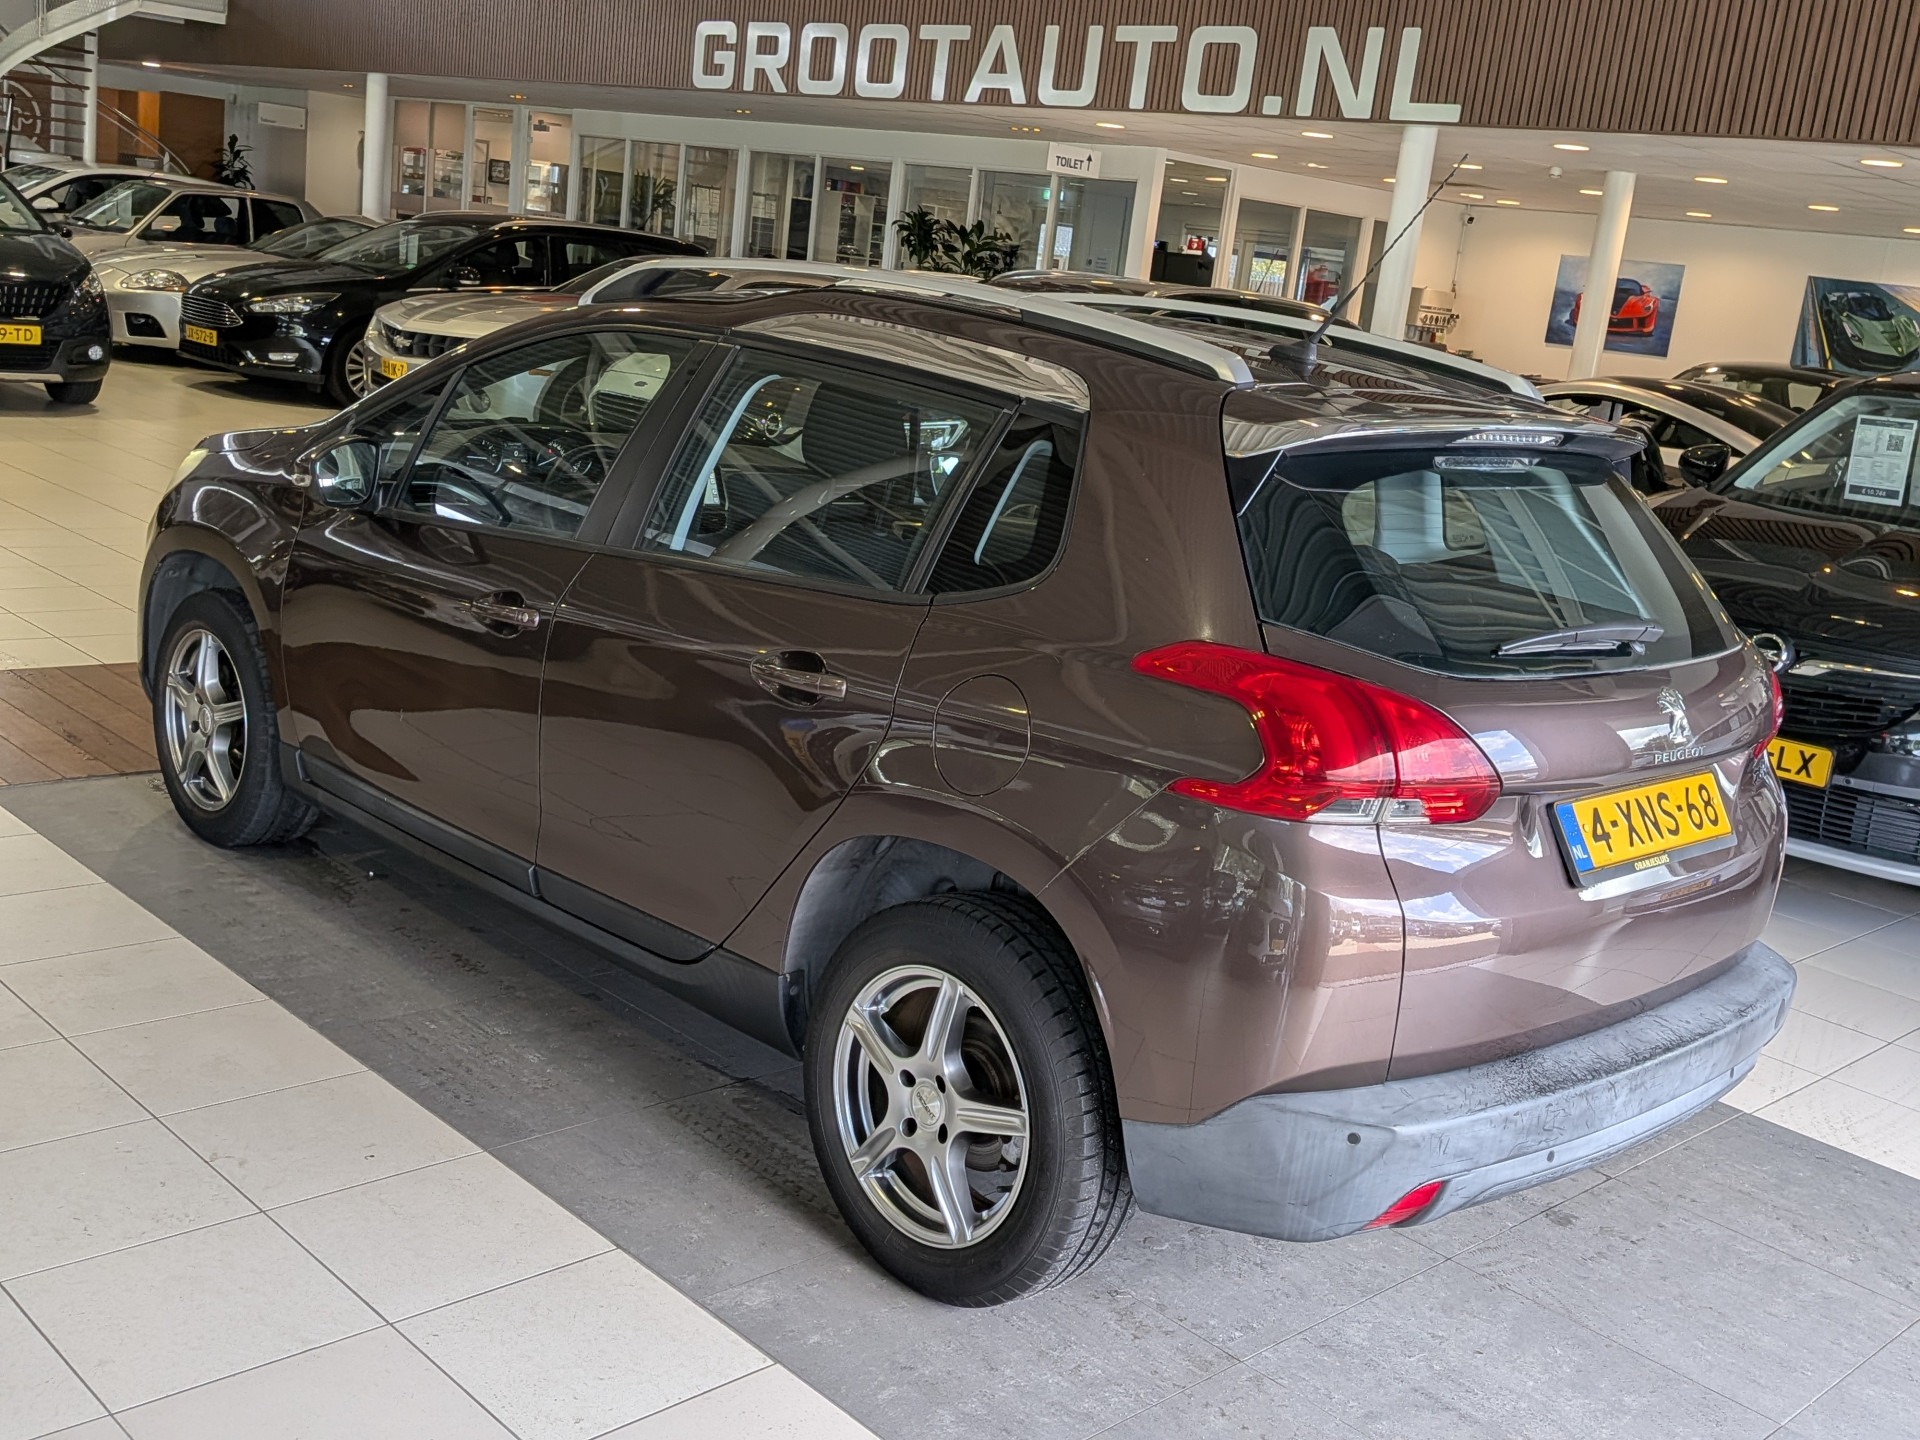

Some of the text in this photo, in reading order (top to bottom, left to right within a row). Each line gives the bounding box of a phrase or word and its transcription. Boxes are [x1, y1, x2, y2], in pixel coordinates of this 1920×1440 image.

[693, 21, 1461, 123] GROOTAUTO.NL
[1056, 155, 1084, 170] TOILET
[1654, 746, 1705, 765] PEUGEOT
[1591, 783, 1720, 853] 4-XNS-68
[1572, 845, 1589, 860] NL
[1634, 854, 1670, 871] ORANJESLUIS
